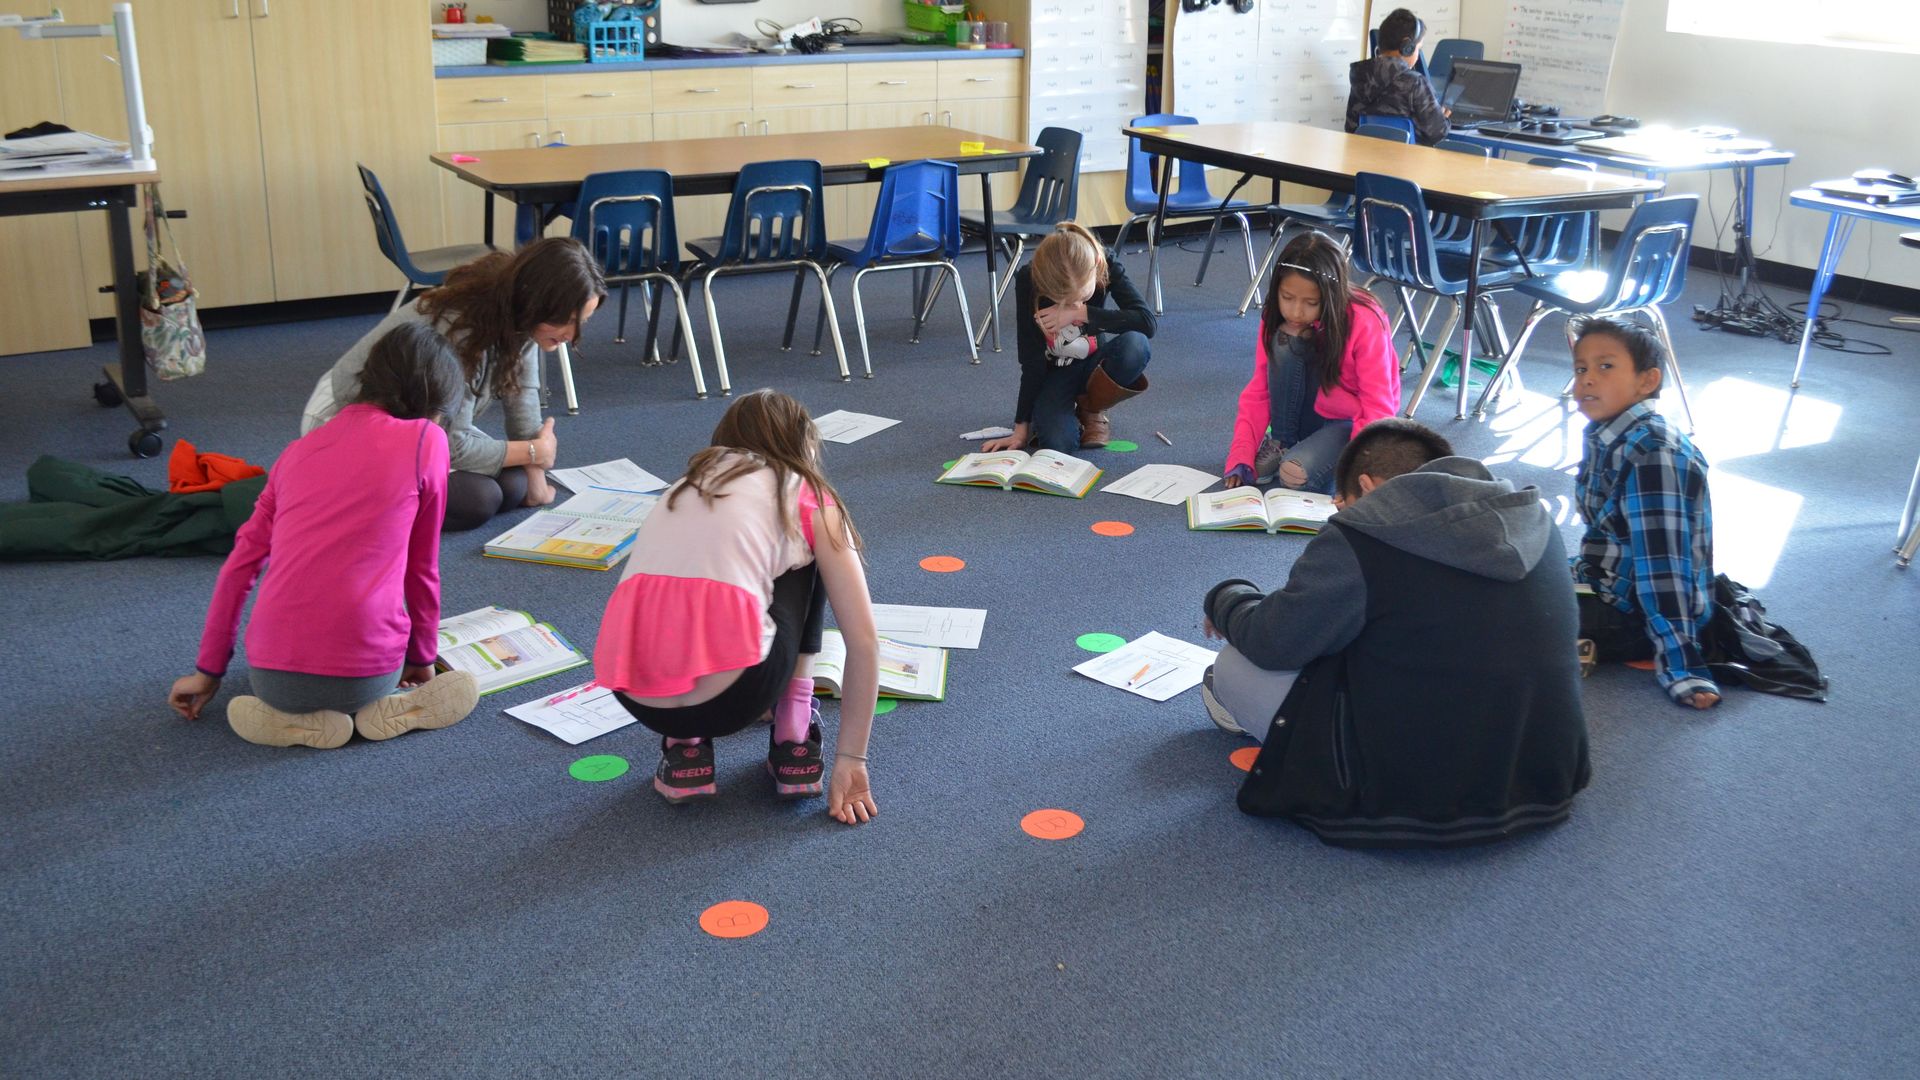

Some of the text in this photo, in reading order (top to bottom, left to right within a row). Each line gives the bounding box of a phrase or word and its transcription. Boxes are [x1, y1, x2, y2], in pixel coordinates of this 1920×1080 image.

[1298, 25, 1320, 36] together
[1114, 52, 1133, 60] round
[671, 765, 713, 778] HEELYS
[778, 763, 819, 775] HEELYS
